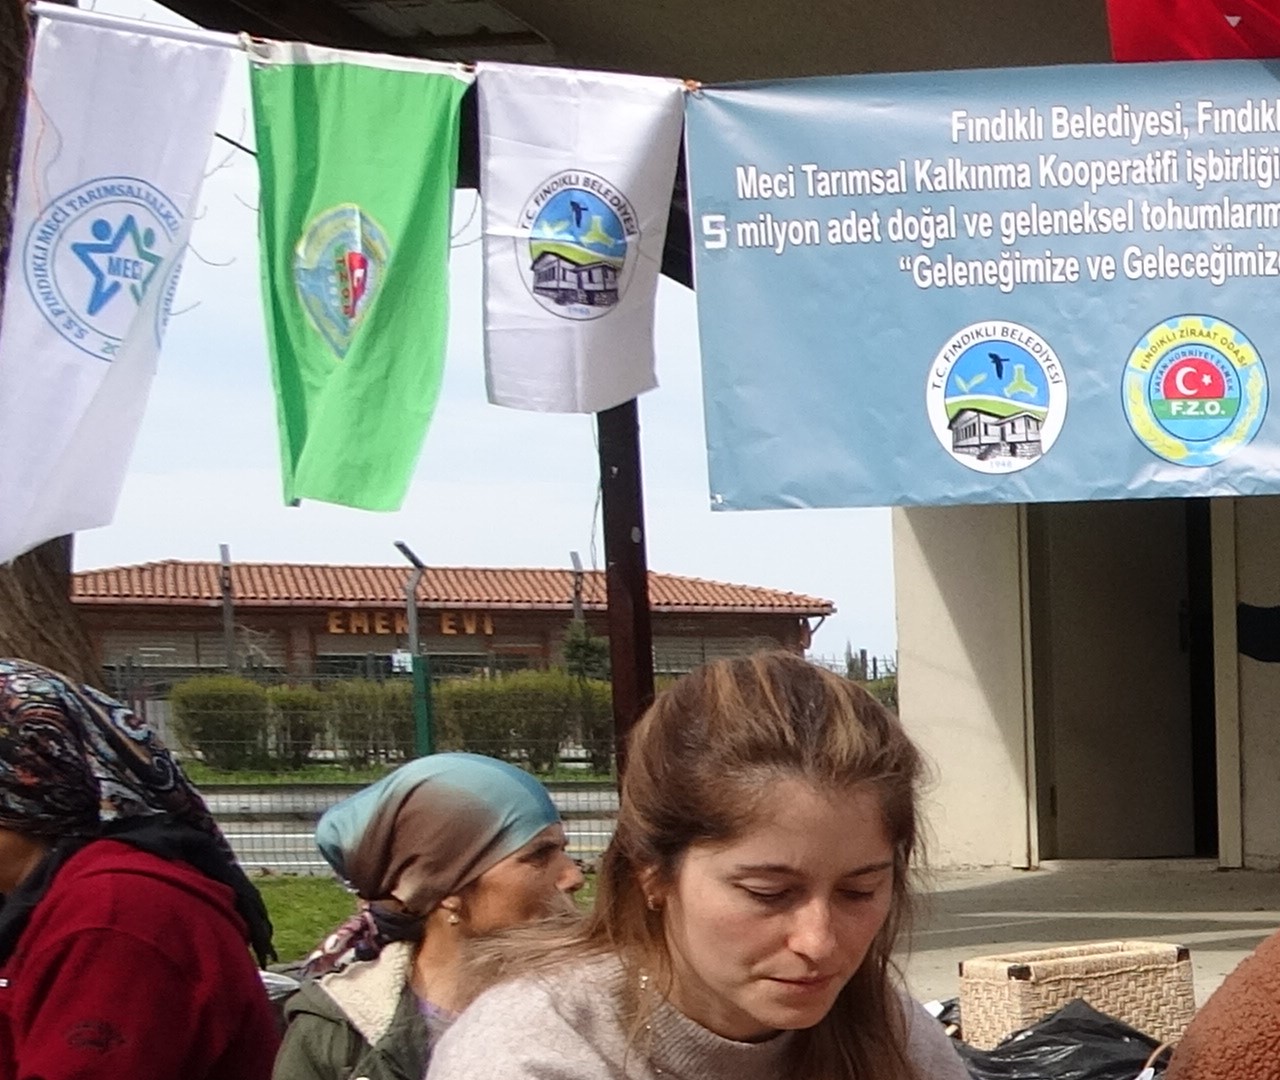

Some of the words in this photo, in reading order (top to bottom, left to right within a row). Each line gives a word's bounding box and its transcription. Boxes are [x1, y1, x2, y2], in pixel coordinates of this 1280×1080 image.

[952, 108, 1044, 143] Fındıklı
[1051, 104, 1190, 145] Belediyesi,
[736, 165, 795, 199] Meci
[800, 159, 908, 197] Tarımsal
[914, 157, 1031, 193] Kalkınma
[1038, 151, 1179, 193] Kooperatifi
[534, 175, 580, 208] FINDIKLI
[582, 176, 638, 237] BELEDİYESİ
[702, 213, 727, 250] 5
[736, 212, 821, 255] milyon
[827, 210, 882, 245] adet
[887, 205, 957, 248] doğal
[963, 211, 993, 239] ve
[1001, 200, 1134, 247] geleneksel
[32, 243, 67, 319] FINDIKLI
[66, 183, 143, 213] TARIMSAL
[1087, 255, 1116, 282] ve
[943, 325, 997, 363] FINDIKLI
[1000, 325, 1064, 385] BELEDİYESİ
[1140, 331, 1178, 372] FINDIKLI
[1178, 327, 1219, 341] ZİRAAT
[1219, 337, 1249, 368] ODASI
[1170, 400, 1226, 417] F.Z.O.
[327, 610, 409, 634] EMEK
